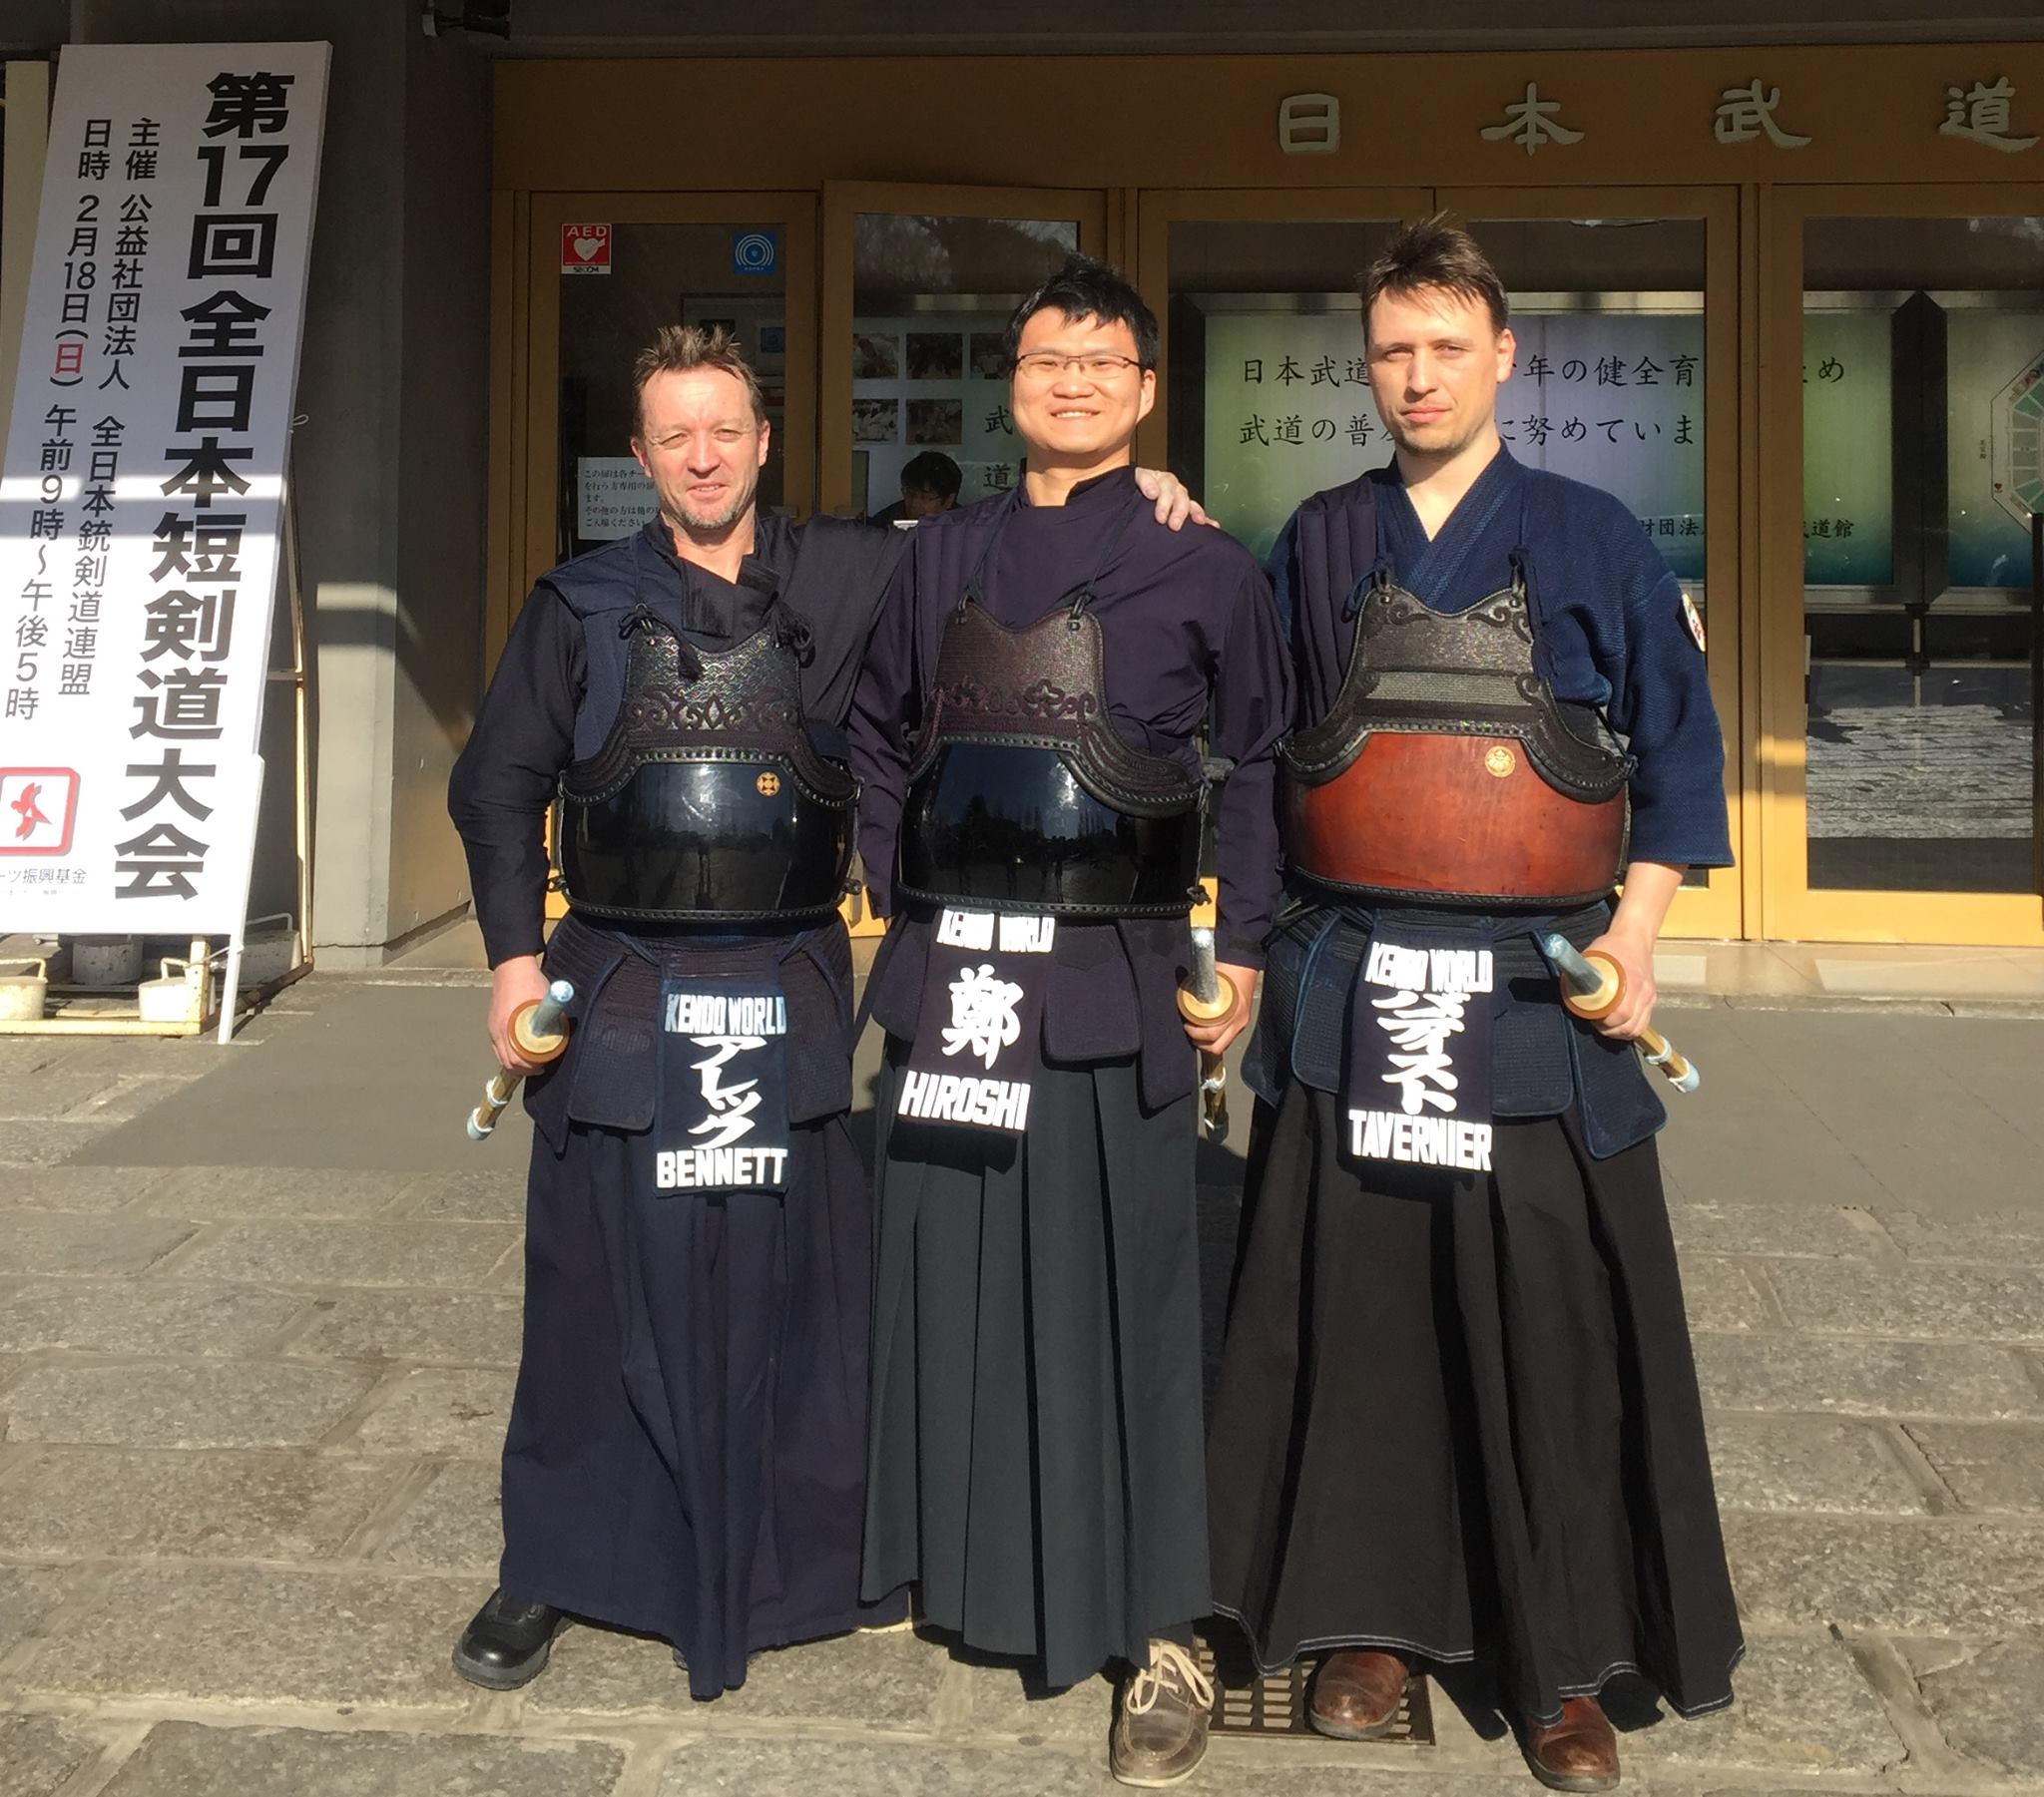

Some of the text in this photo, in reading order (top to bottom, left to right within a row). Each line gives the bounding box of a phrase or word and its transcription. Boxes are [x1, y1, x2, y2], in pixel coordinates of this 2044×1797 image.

[1278, 76, 2041, 156] 日本武道
[78, 119, 113, 181] 日時
[567, 225, 607, 237] AED
[1512, 353, 1699, 387] 年の健全育
[57, 117, 161, 695] 主催 公益社団法人 全日本銃剣道連盟
[984, 405, 1013, 435] 武
[114, 72, 295, 900] 第17回全日本短剣道大会
[983, 463, 1013, 491] 道
[1639, 518, 1706, 538] 財団法
[1364, 942, 1494, 993] KENDO WORLD
[664, 994, 787, 1036] KENDO WORLD
[897, 1070, 1032, 1131] HIROSHI
[1348, 1109, 1493, 1172] TAVERNIER
[656, 1147, 788, 1189] BENNETT
